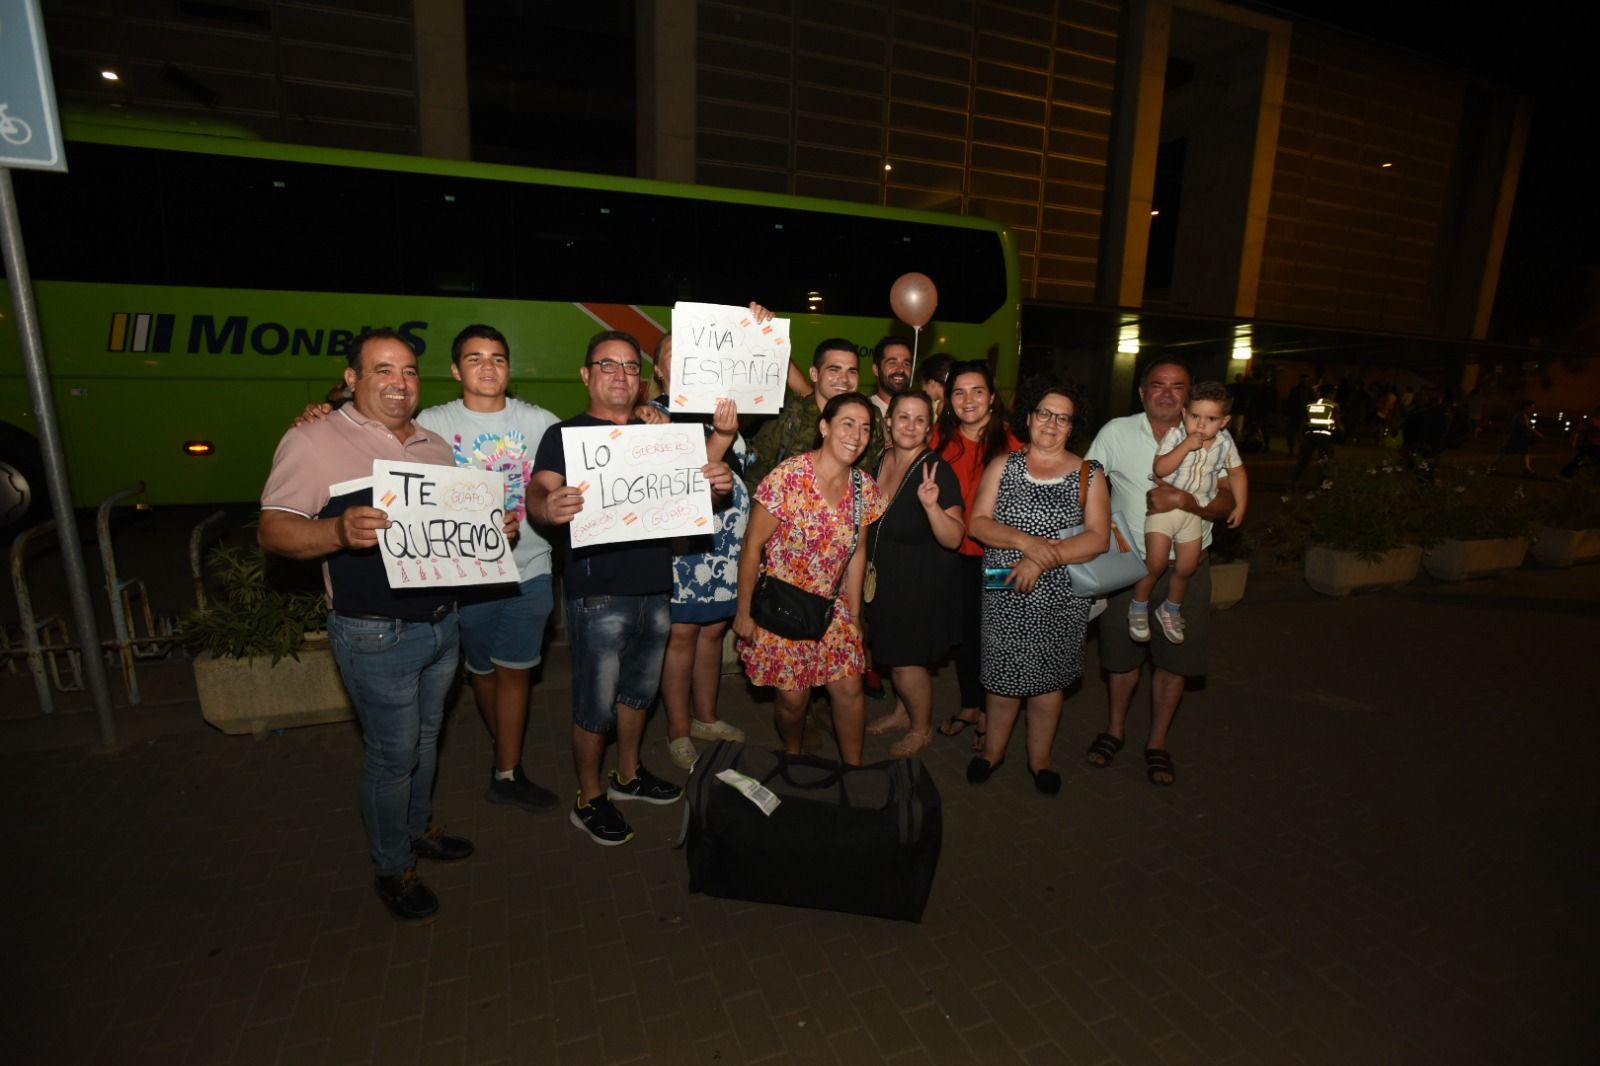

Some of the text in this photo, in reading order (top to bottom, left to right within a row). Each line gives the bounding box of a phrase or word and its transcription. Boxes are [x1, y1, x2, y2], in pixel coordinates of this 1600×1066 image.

[187, 314, 428, 357] MONBS
[682, 354, 780, 386] ESPAÑA
[582, 441, 611, 471] LO
[388, 471, 437, 507] TE
[599, 467, 705, 509] LOGRASTE
[383, 508, 505, 562] QUEREMOS
